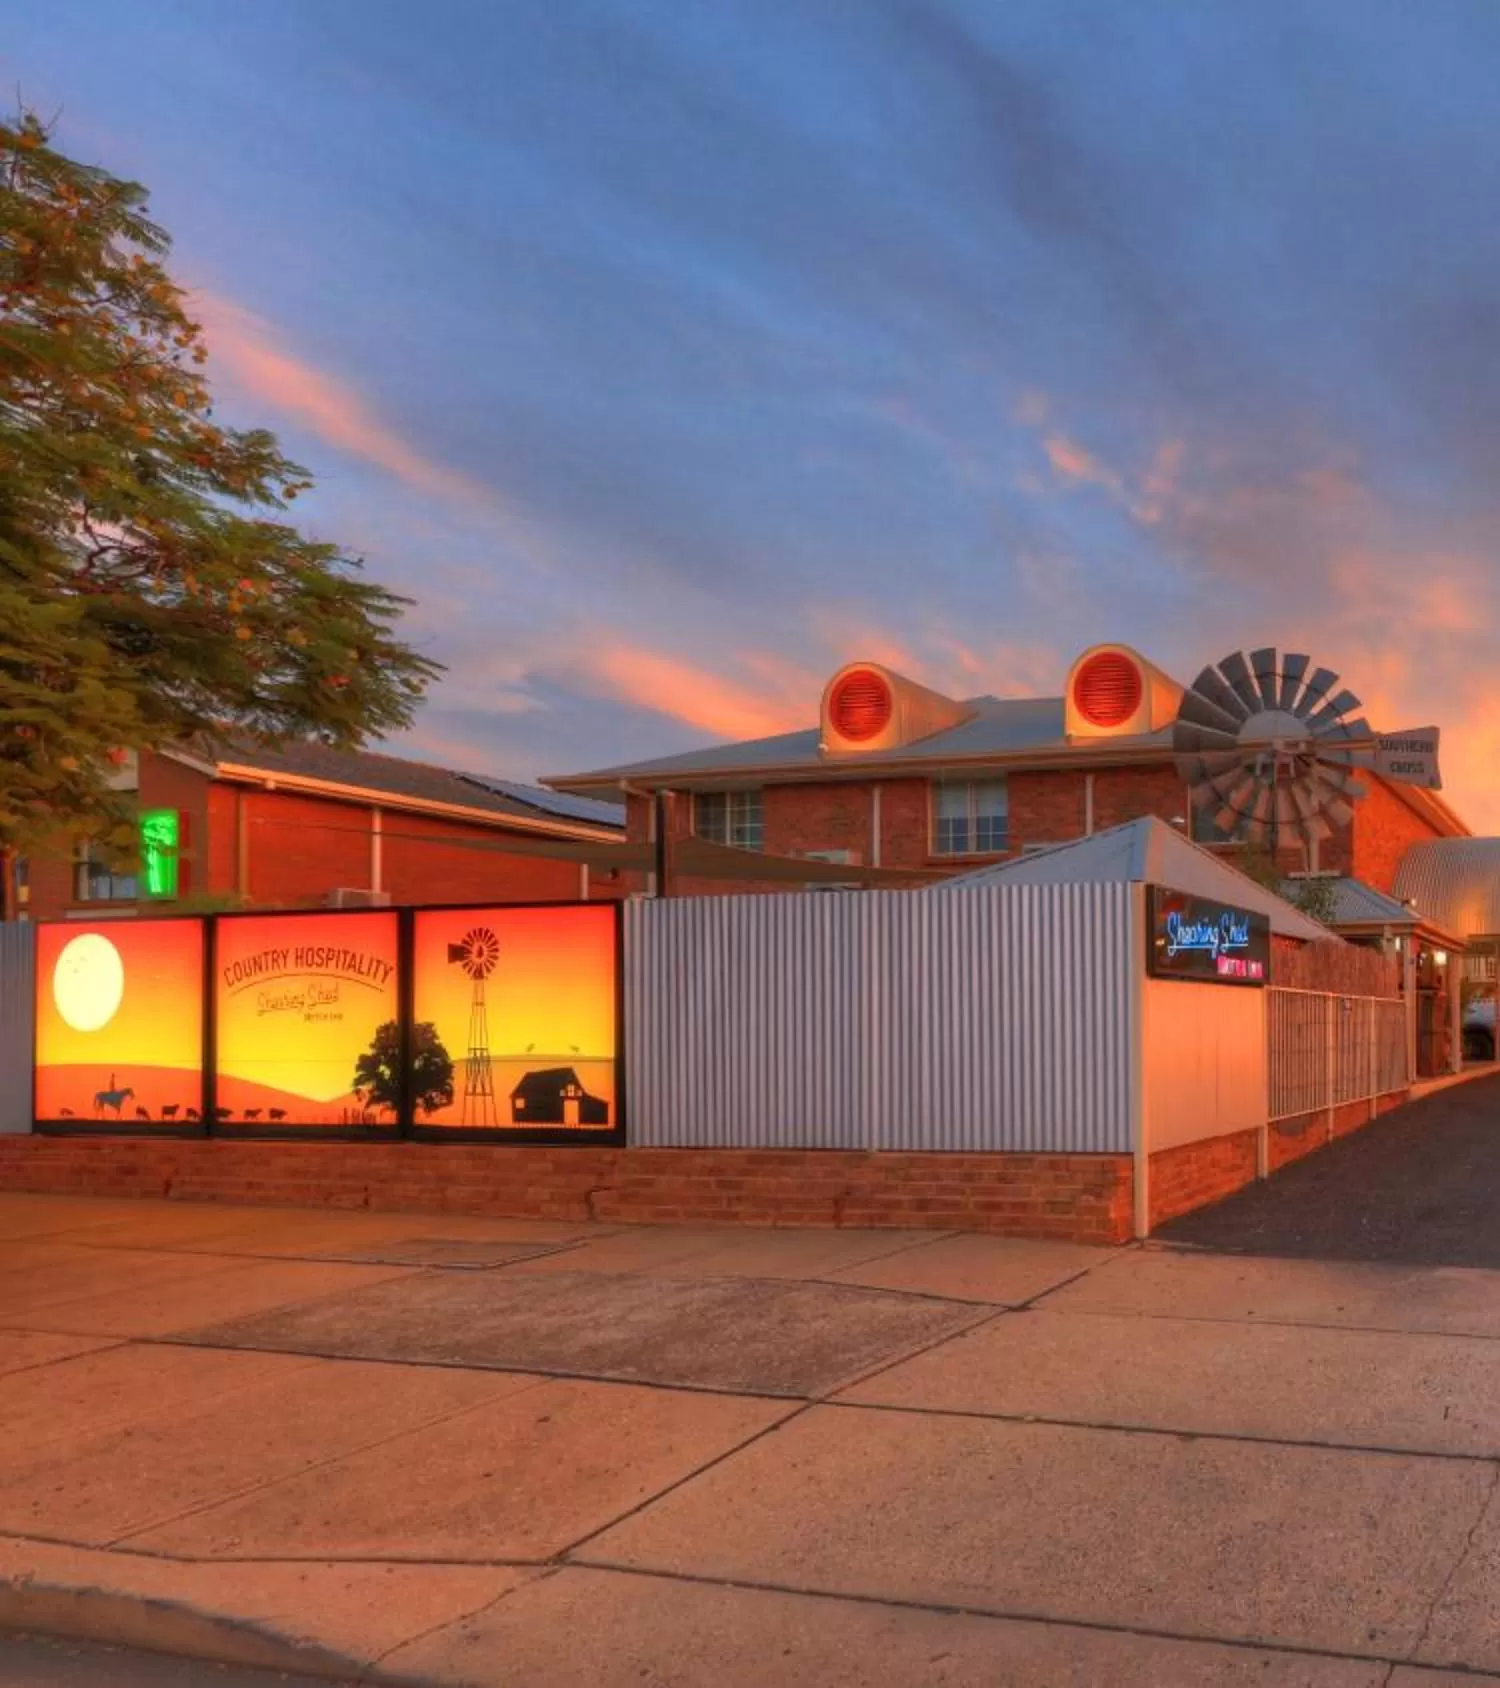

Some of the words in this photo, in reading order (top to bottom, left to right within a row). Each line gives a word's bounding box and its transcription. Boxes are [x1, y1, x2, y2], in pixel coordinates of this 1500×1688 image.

[1167, 911, 1219, 960] Shearing
[223, 947, 290, 988] COUNTRY
[294, 946, 394, 984] HOSPITALITY
